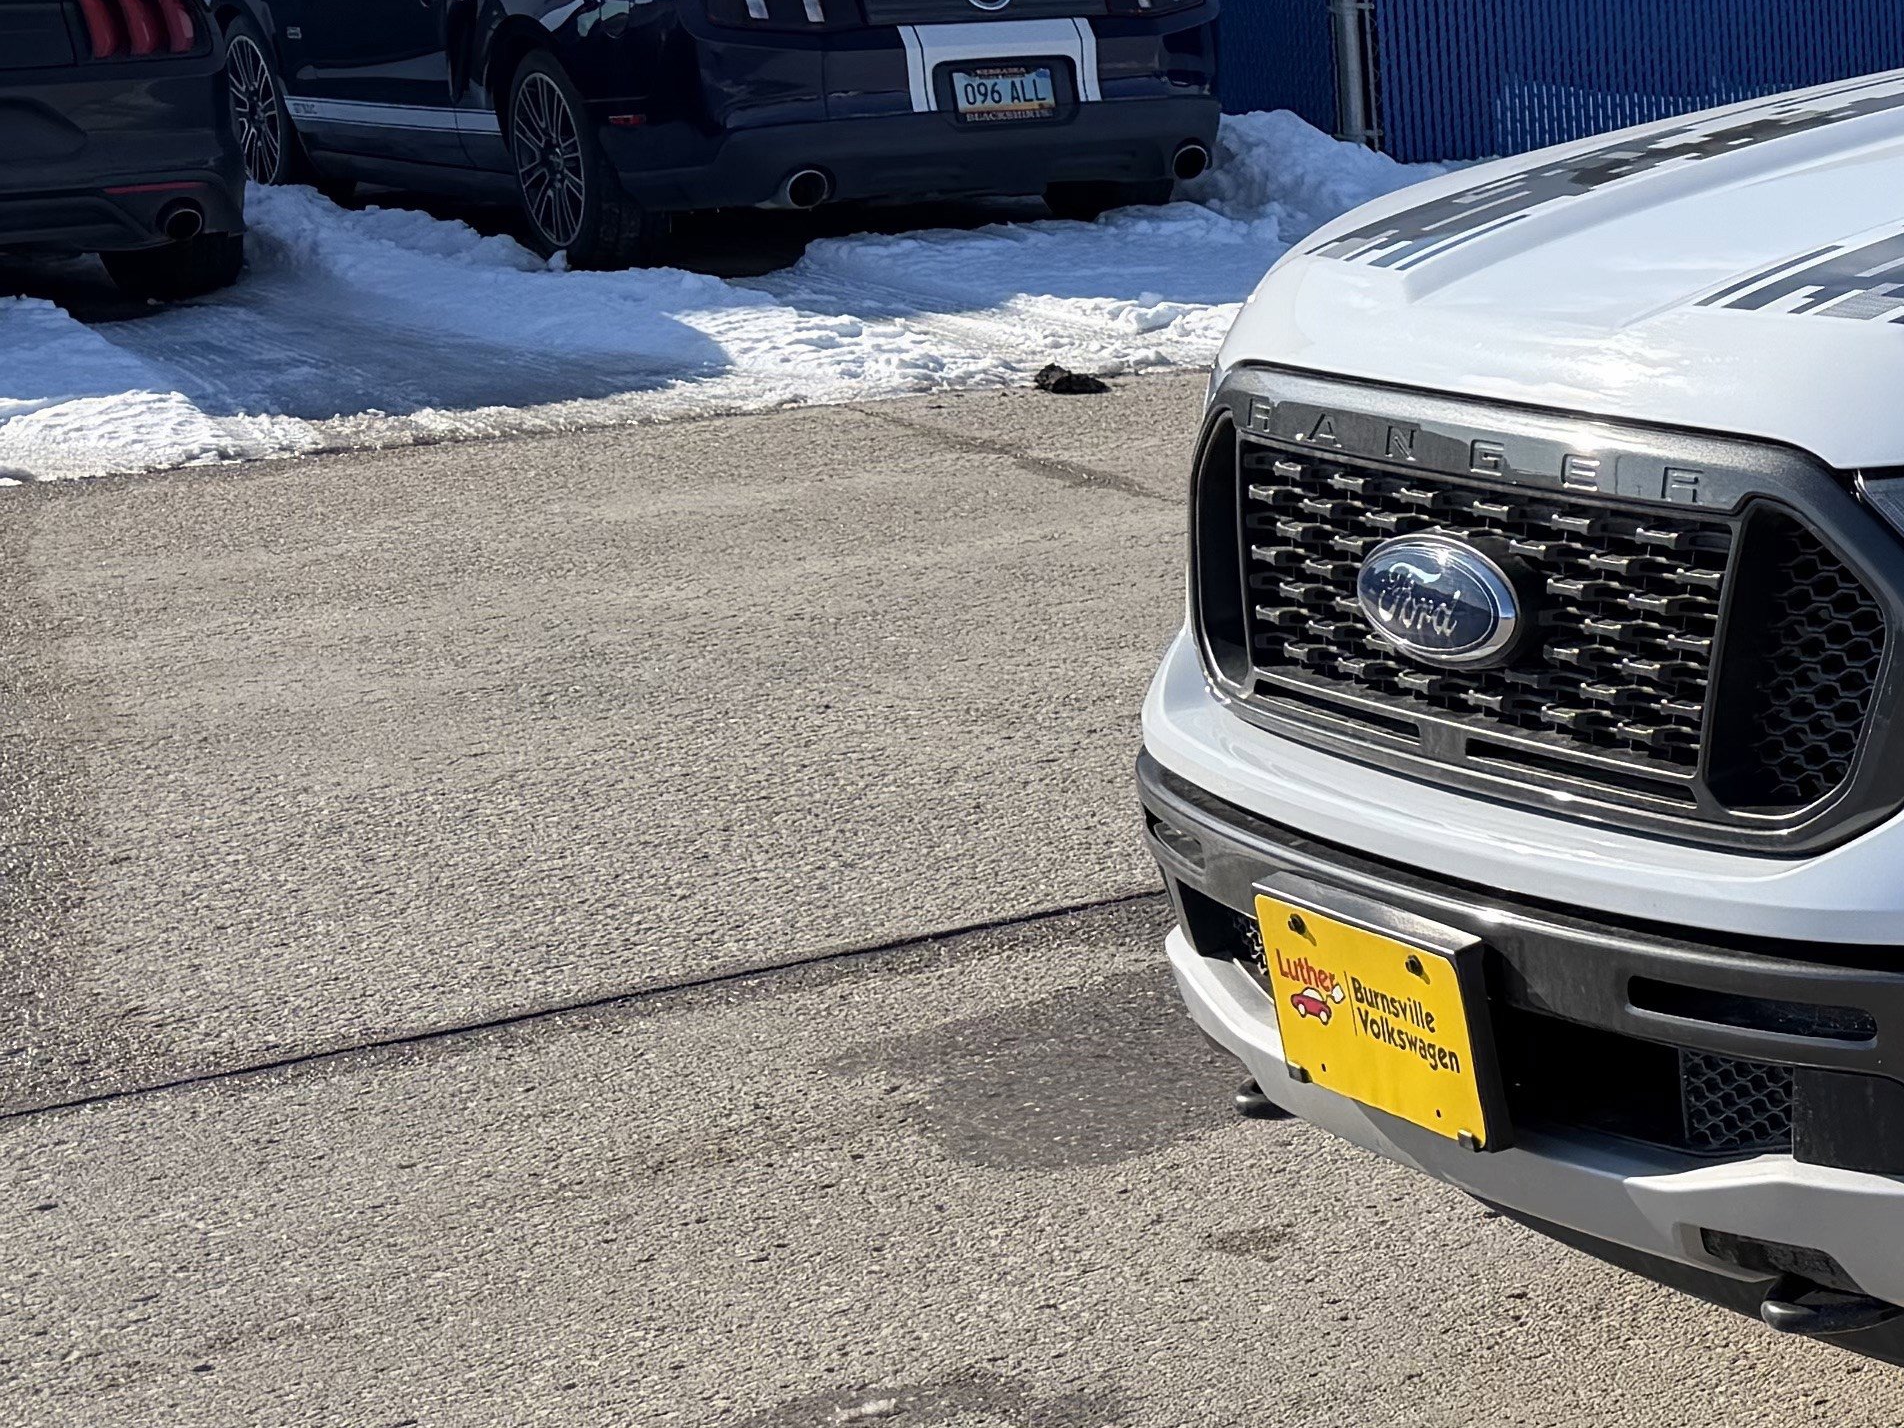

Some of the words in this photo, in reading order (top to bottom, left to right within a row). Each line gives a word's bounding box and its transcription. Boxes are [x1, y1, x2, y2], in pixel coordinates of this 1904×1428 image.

[964, 81, 1002, 106] 096
[1010, 79, 1047, 104] ALL
[1246, 397, 1704, 504] RANGER
[1376, 560, 1462, 637] Ford
[1275, 948, 1336, 992] Luther
[1351, 976, 1436, 1034] Burnsville
[1357, 1007, 1461, 1074] Volkswagen
